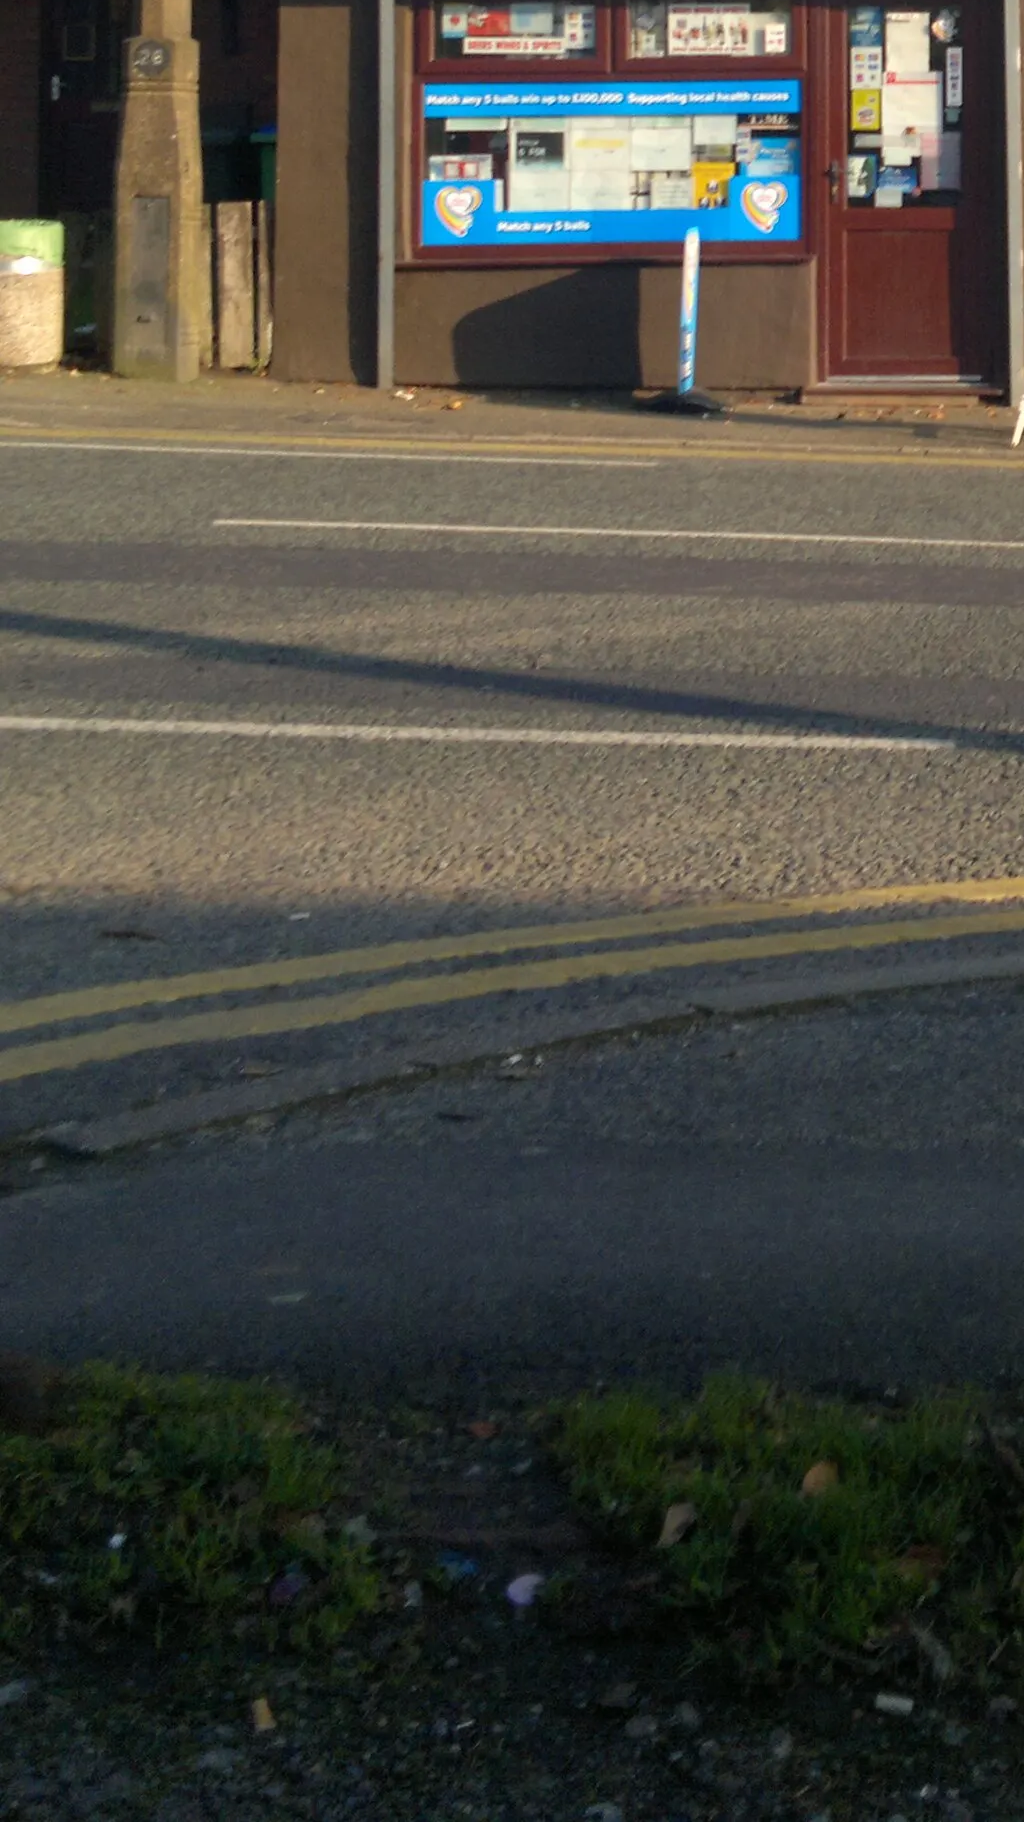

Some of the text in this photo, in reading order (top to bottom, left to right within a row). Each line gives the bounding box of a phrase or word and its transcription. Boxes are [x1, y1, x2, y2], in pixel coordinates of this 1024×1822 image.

[427, 93, 461, 105] Match
[462, 95, 482, 107] any
[484, 94, 491, 105] 5
[493, 93, 520, 105] balls
[520, 93, 540, 104] win
[627, 92, 688, 106] Supporting
[497, 220, 591, 233] Match any 5 balls
